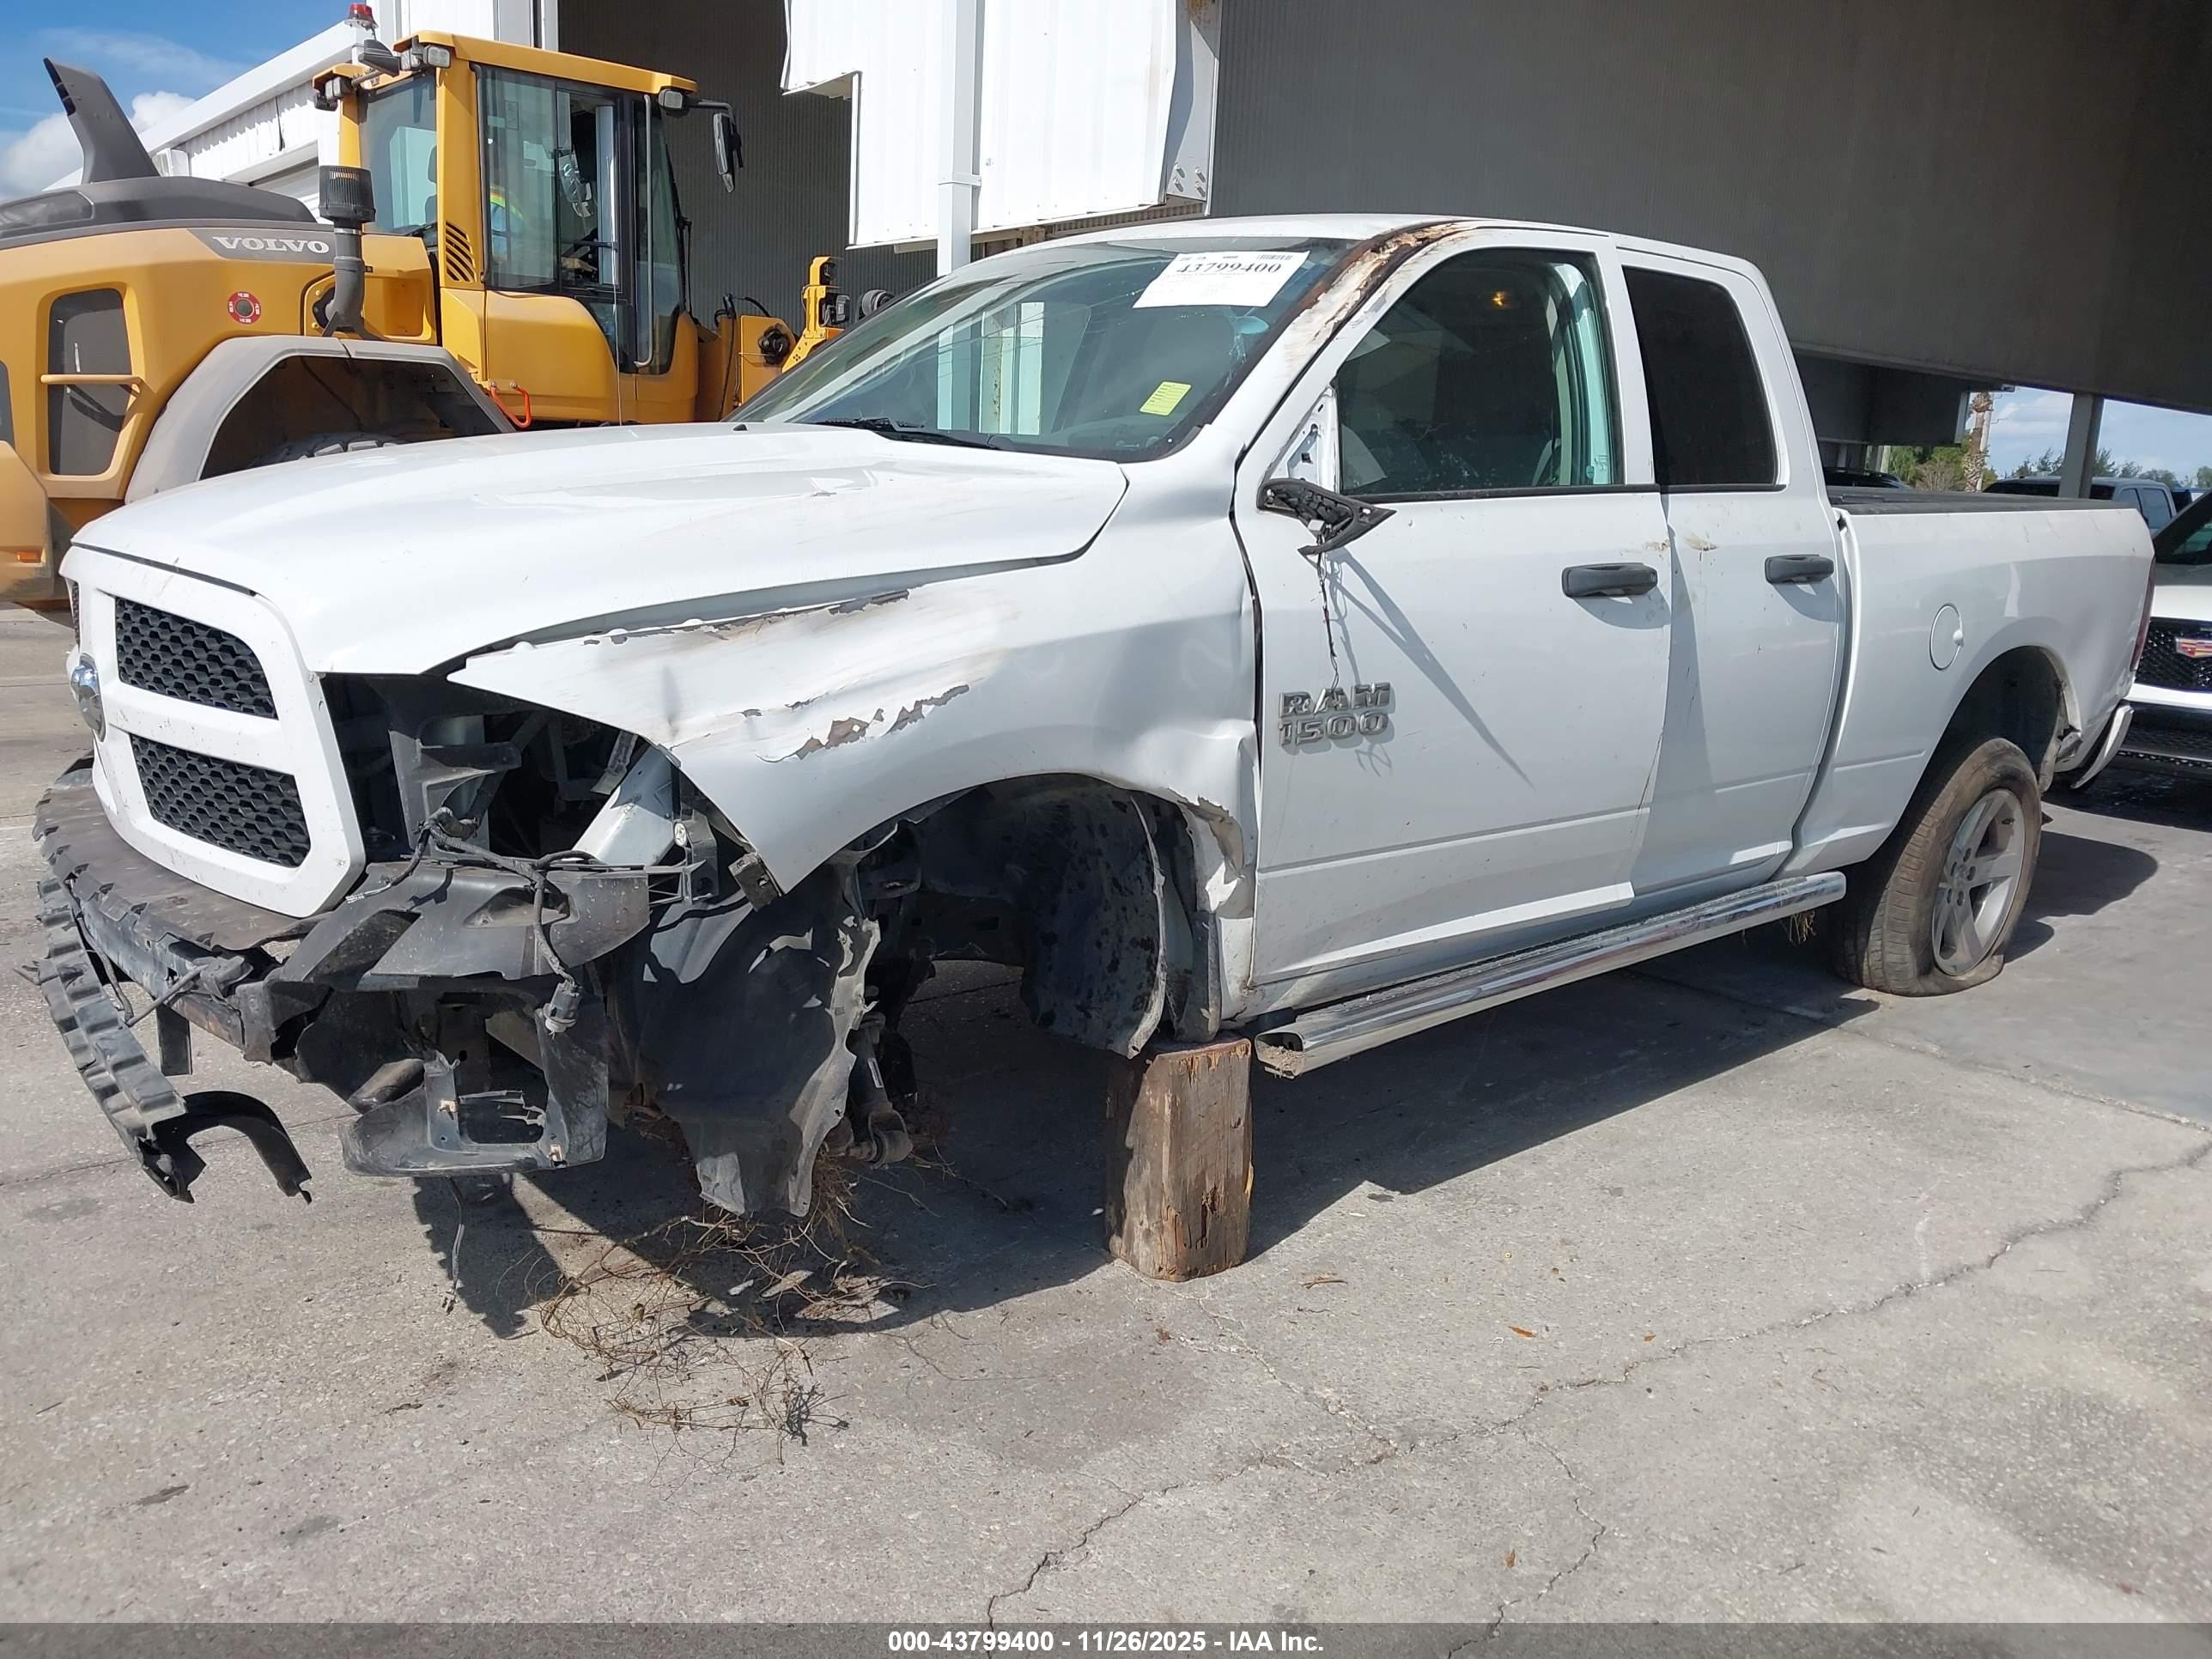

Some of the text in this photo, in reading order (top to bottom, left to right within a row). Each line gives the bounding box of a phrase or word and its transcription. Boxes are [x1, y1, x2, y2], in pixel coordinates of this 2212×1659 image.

[212, 236, 330, 254] VOLVO
[1176, 263, 1282, 273] 43799400
[1279, 681, 1392, 719] RAM
[1278, 709, 1390, 747] 1500
